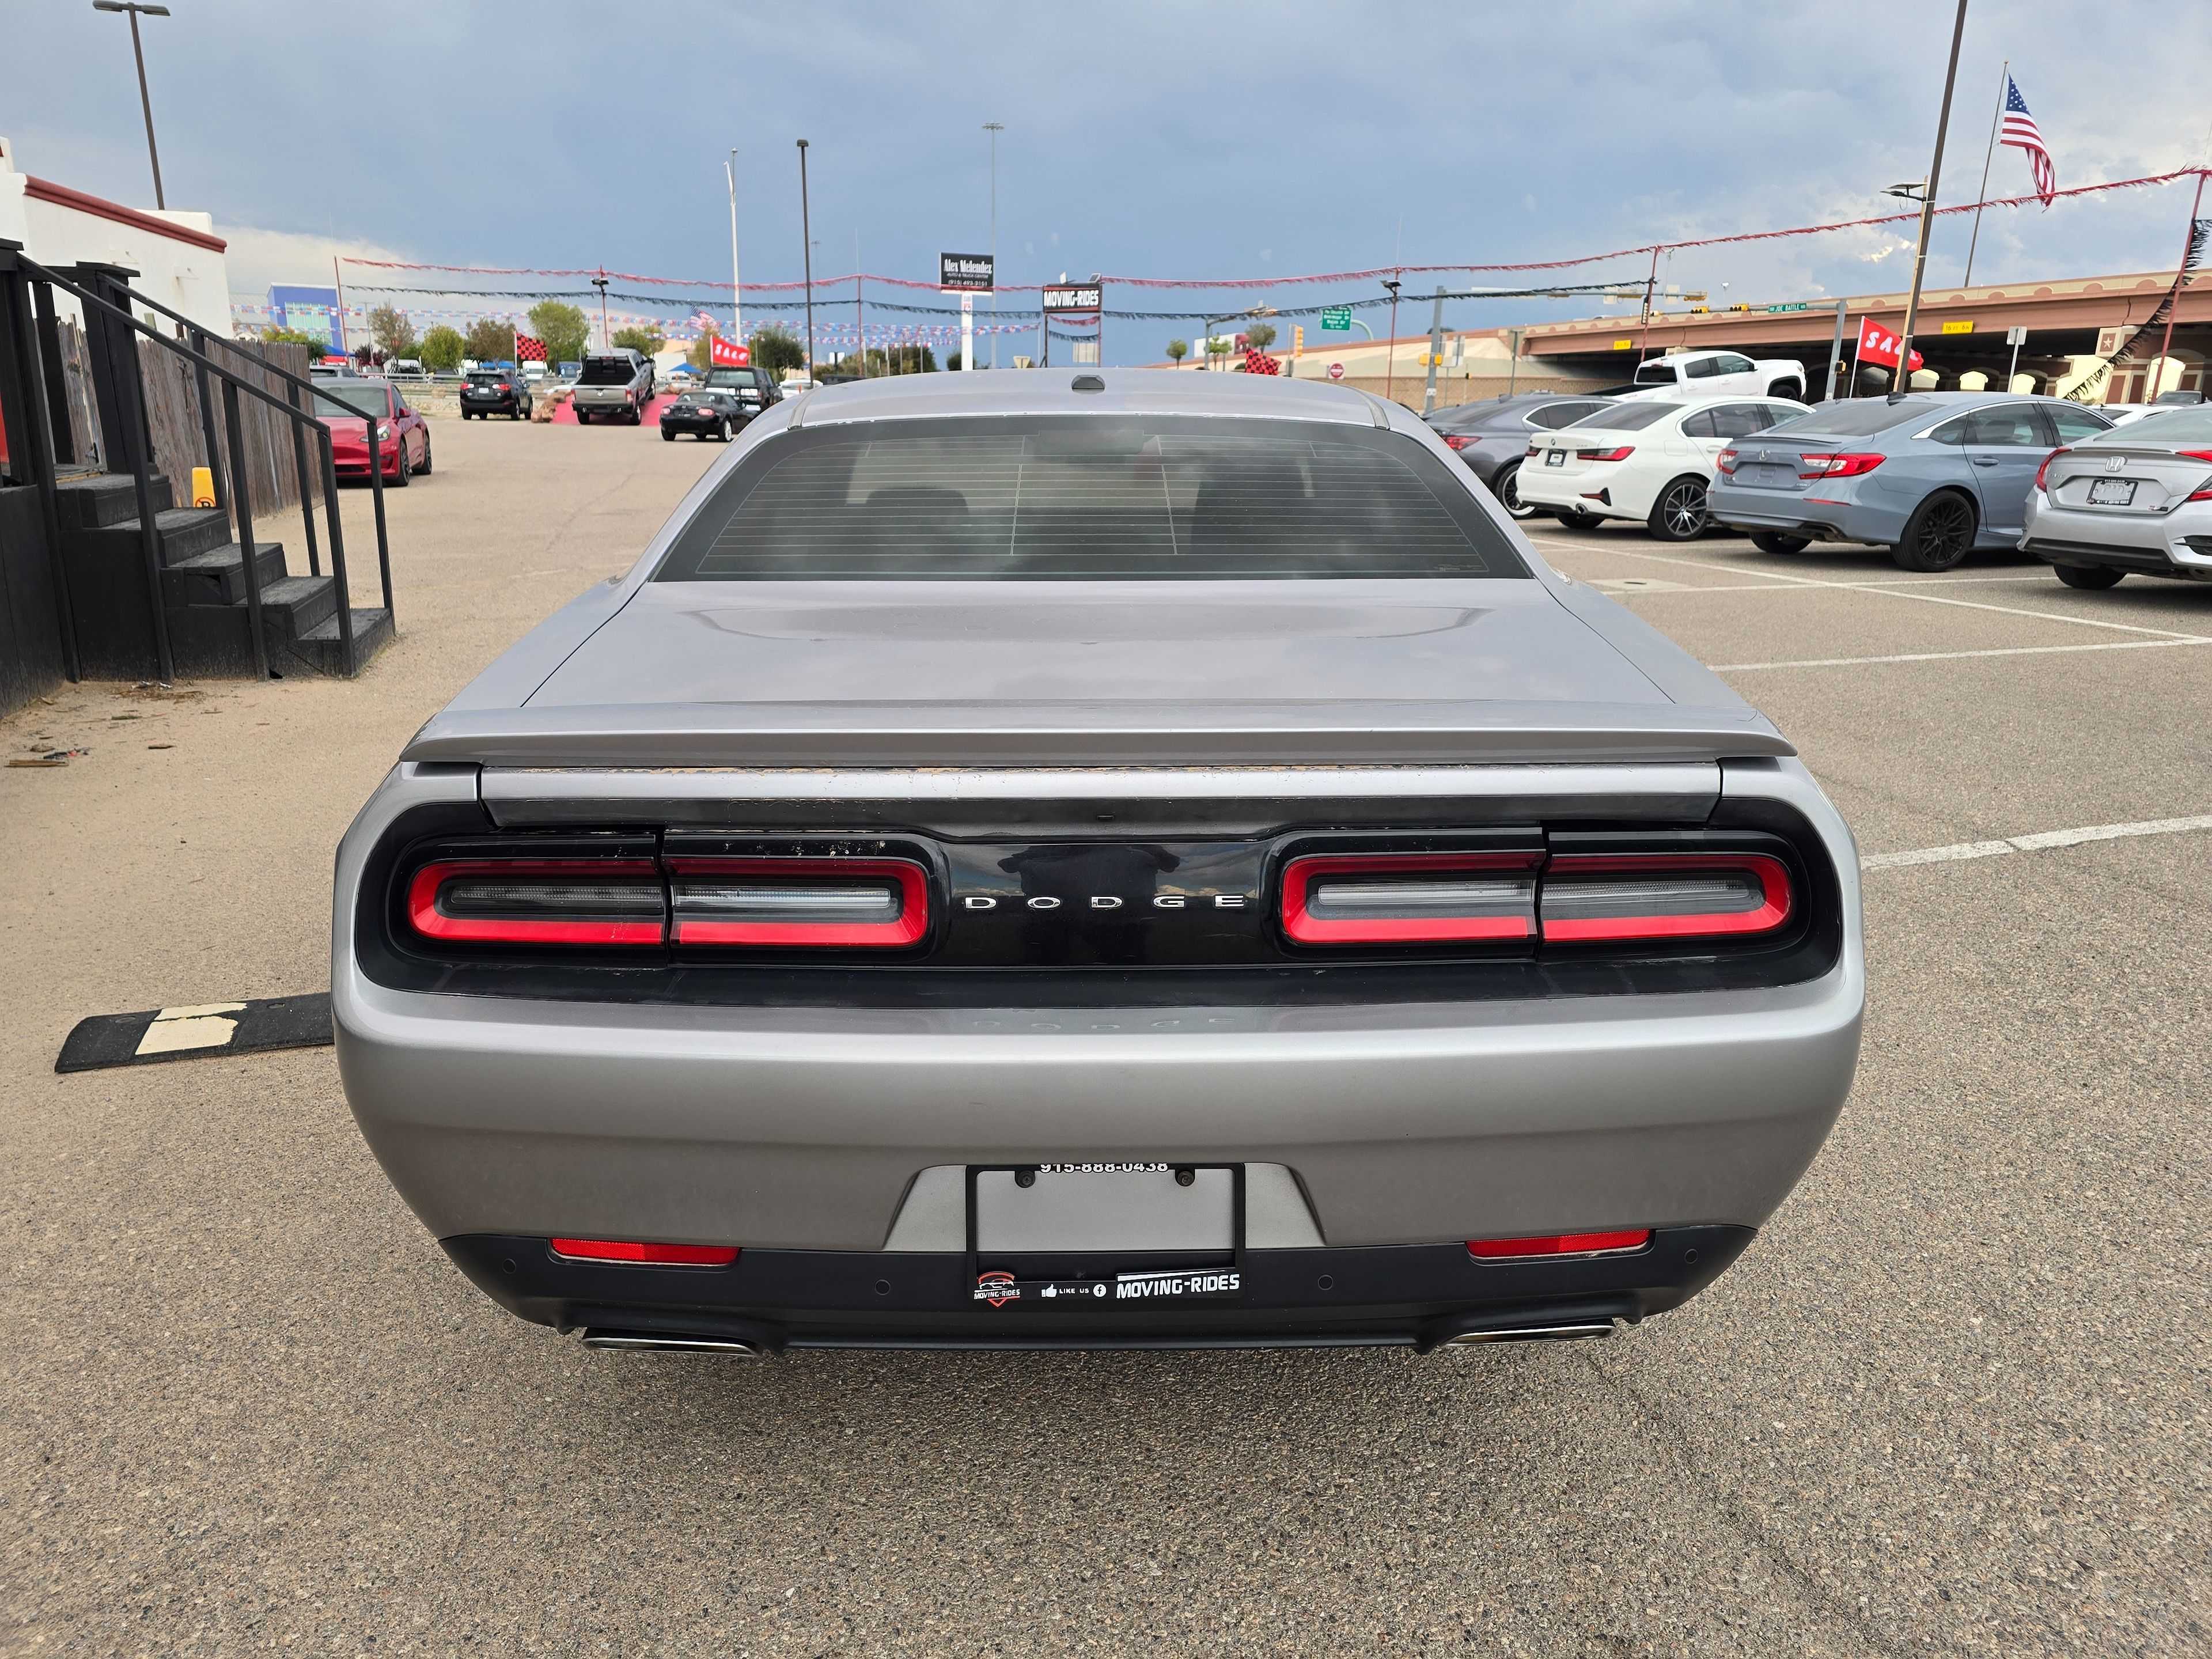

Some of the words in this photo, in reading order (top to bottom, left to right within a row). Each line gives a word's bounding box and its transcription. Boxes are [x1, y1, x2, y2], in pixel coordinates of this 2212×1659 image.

[944, 258, 959, 272] Alex
[960, 259, 993, 274] Melendez
[1044, 290, 1099, 307] MOVING-RIDES
[965, 895, 1244, 908] DODGE
[1040, 1162, 1168, 1173] 915-888-0438
[1116, 1274, 1240, 1298] MOVING-RIDES
[974, 1289, 1020, 1300] MOVING-RIDES
